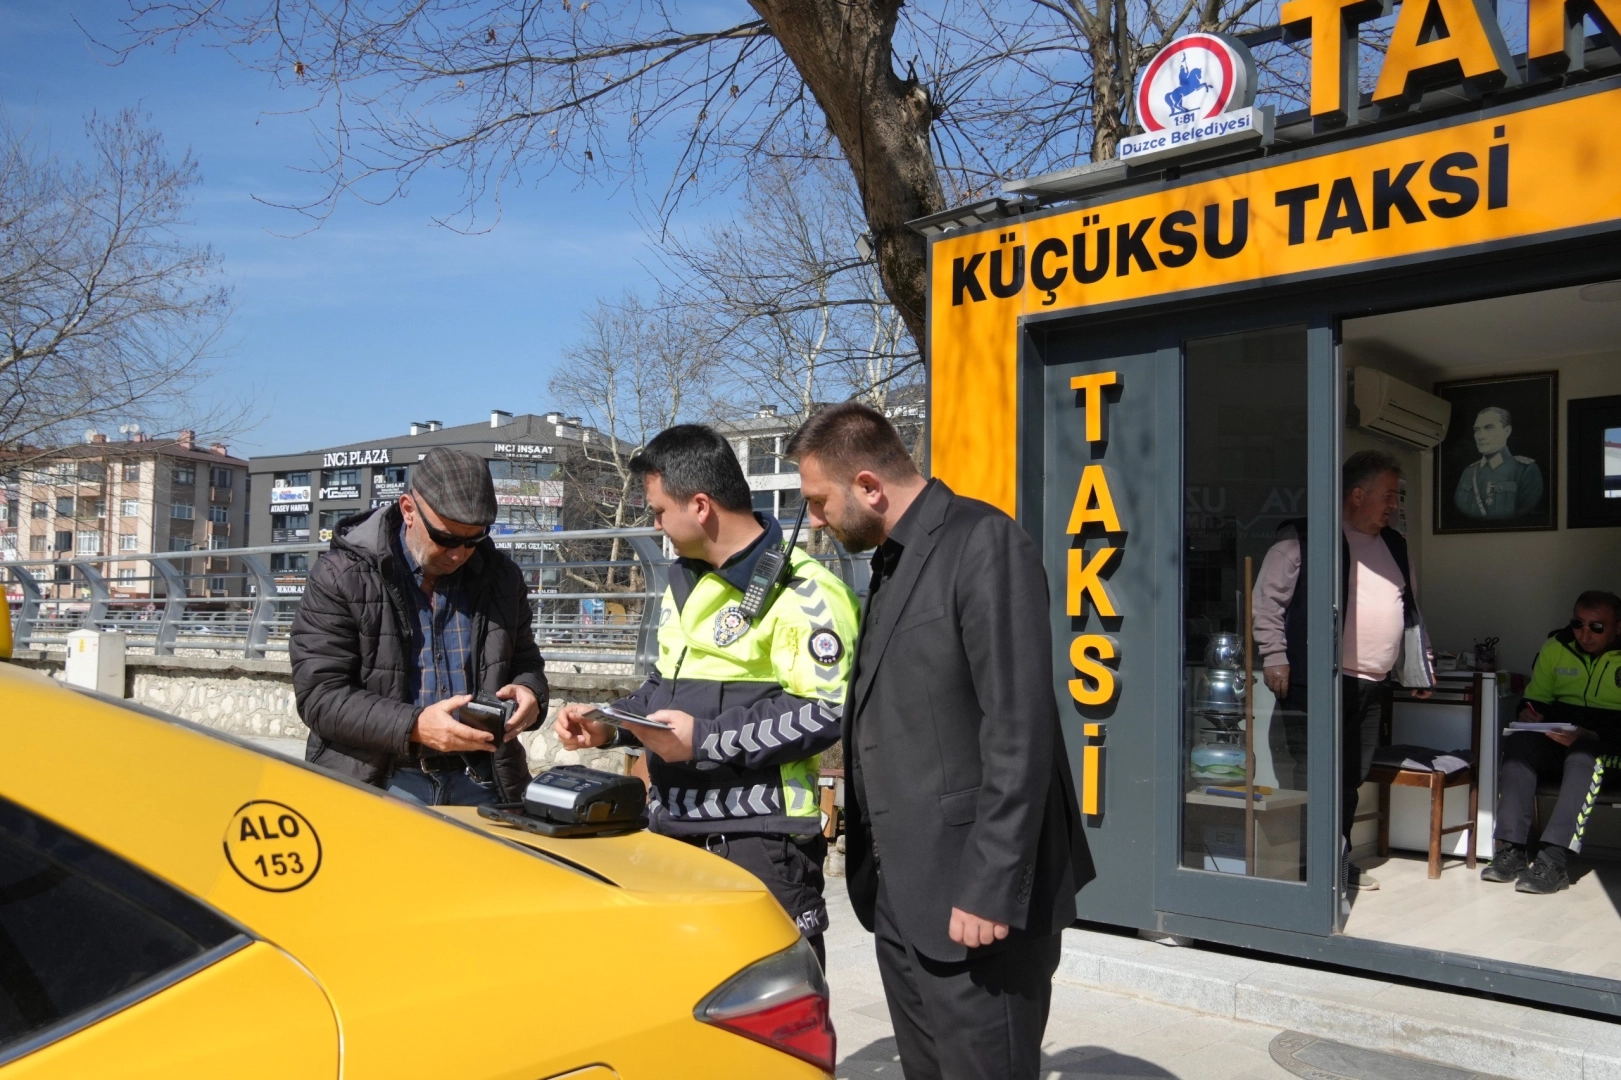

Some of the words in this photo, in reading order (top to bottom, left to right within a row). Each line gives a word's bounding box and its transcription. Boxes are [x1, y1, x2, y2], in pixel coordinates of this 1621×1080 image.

[1122, 138, 1166, 156] Düzce
[1171, 115, 1250, 144] Belediyesi
[952, 197, 1249, 307] KÜÇÜKSU
[1275, 126, 1509, 247] TAKSİ
[349, 449, 390, 466] PLAZA
[240, 814, 300, 842] ALO
[254, 852, 304, 877] 153
